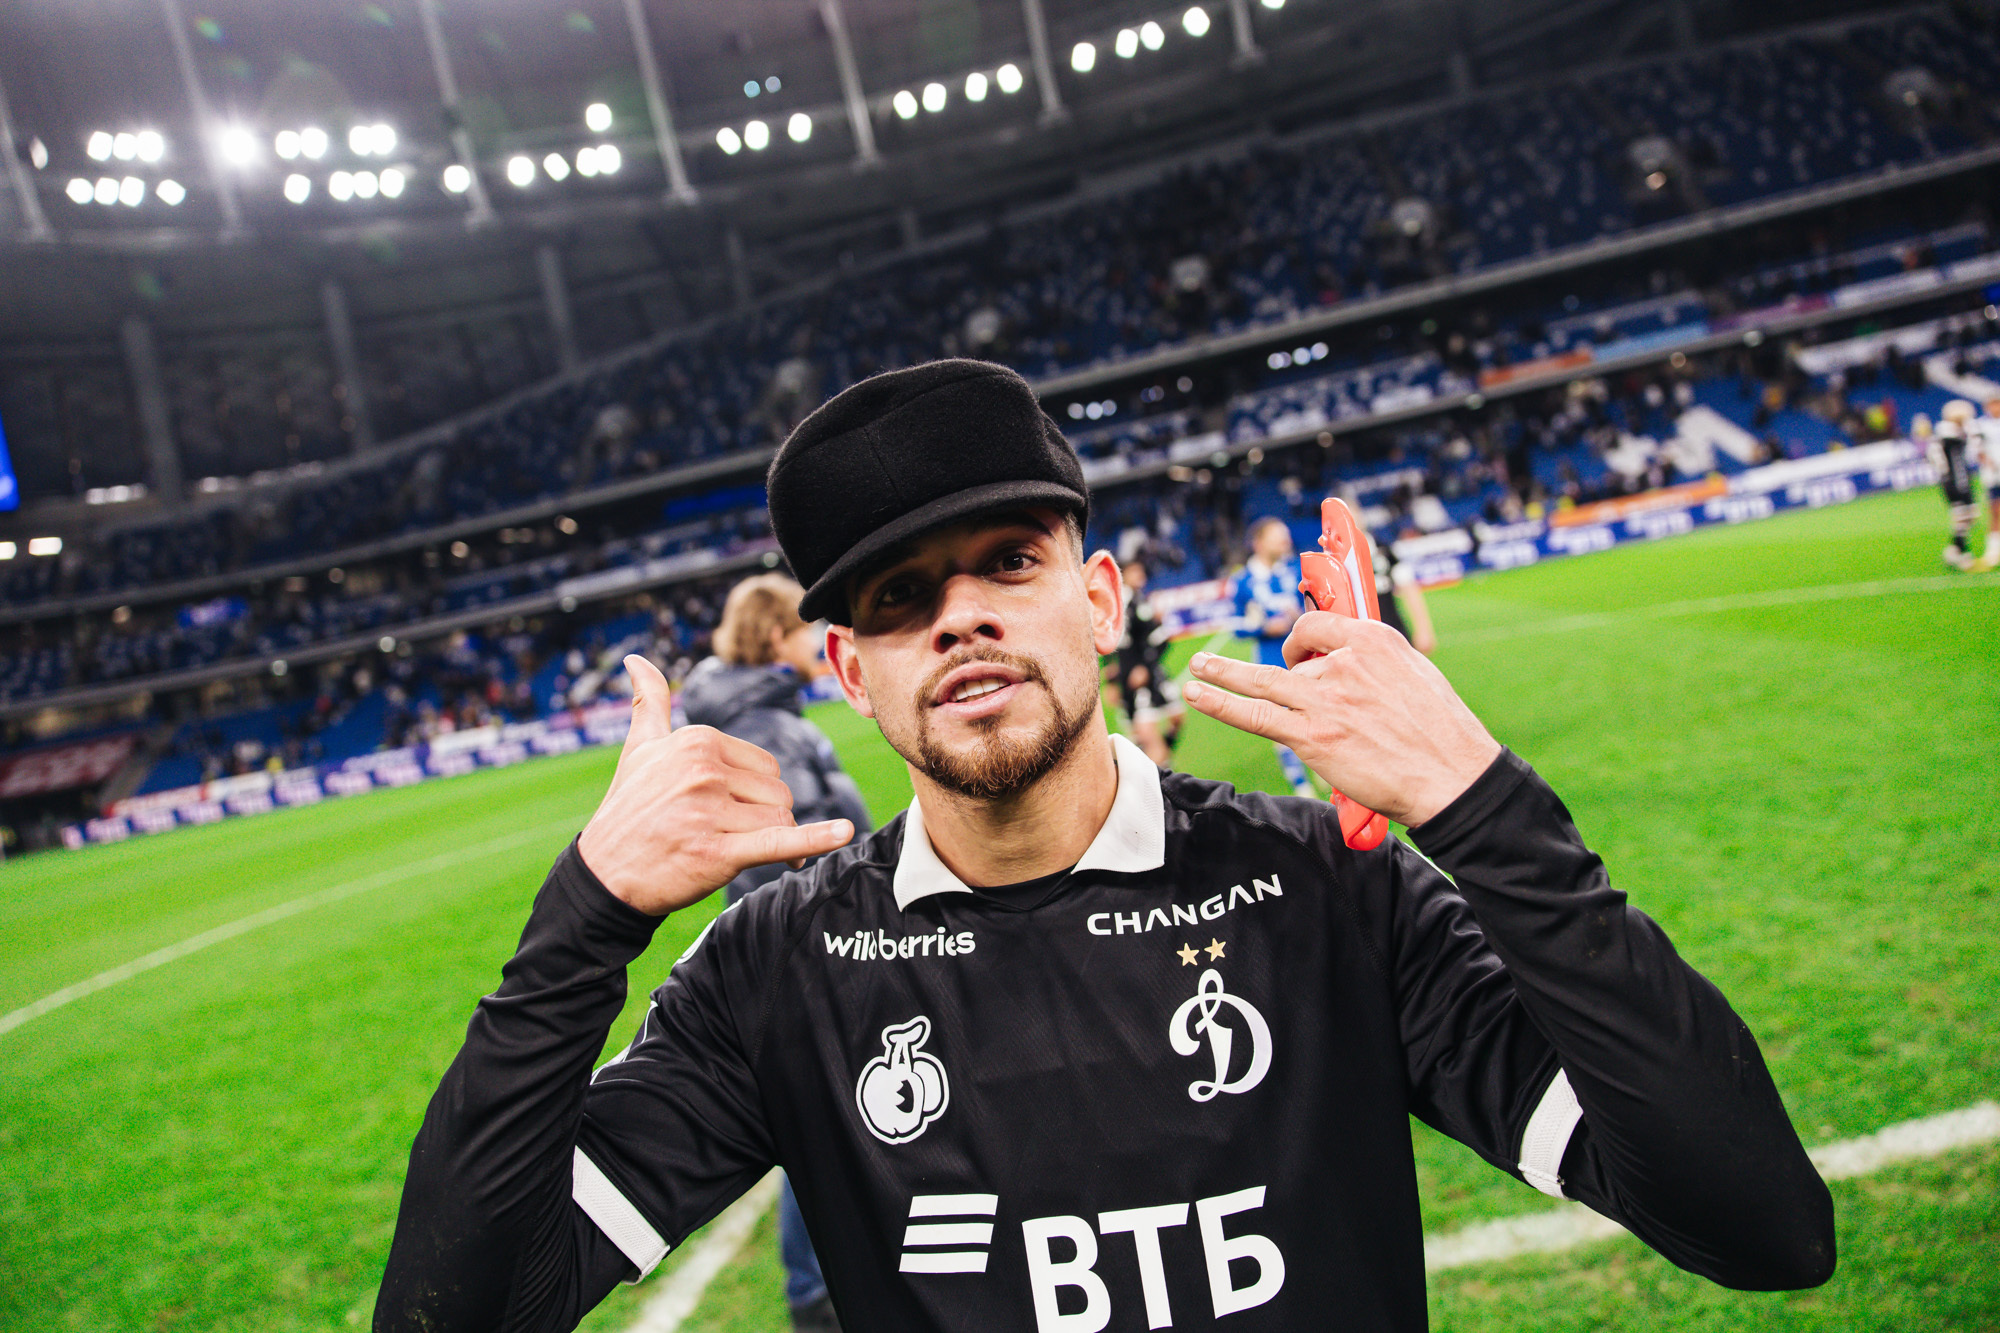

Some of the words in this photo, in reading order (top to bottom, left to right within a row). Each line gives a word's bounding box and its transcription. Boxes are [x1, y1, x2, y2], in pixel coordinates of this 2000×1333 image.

[1086, 873, 1283, 936] CHANGAN
[823, 926, 976, 961] wildberries
[1021, 1185, 1286, 1333] ВТБ
